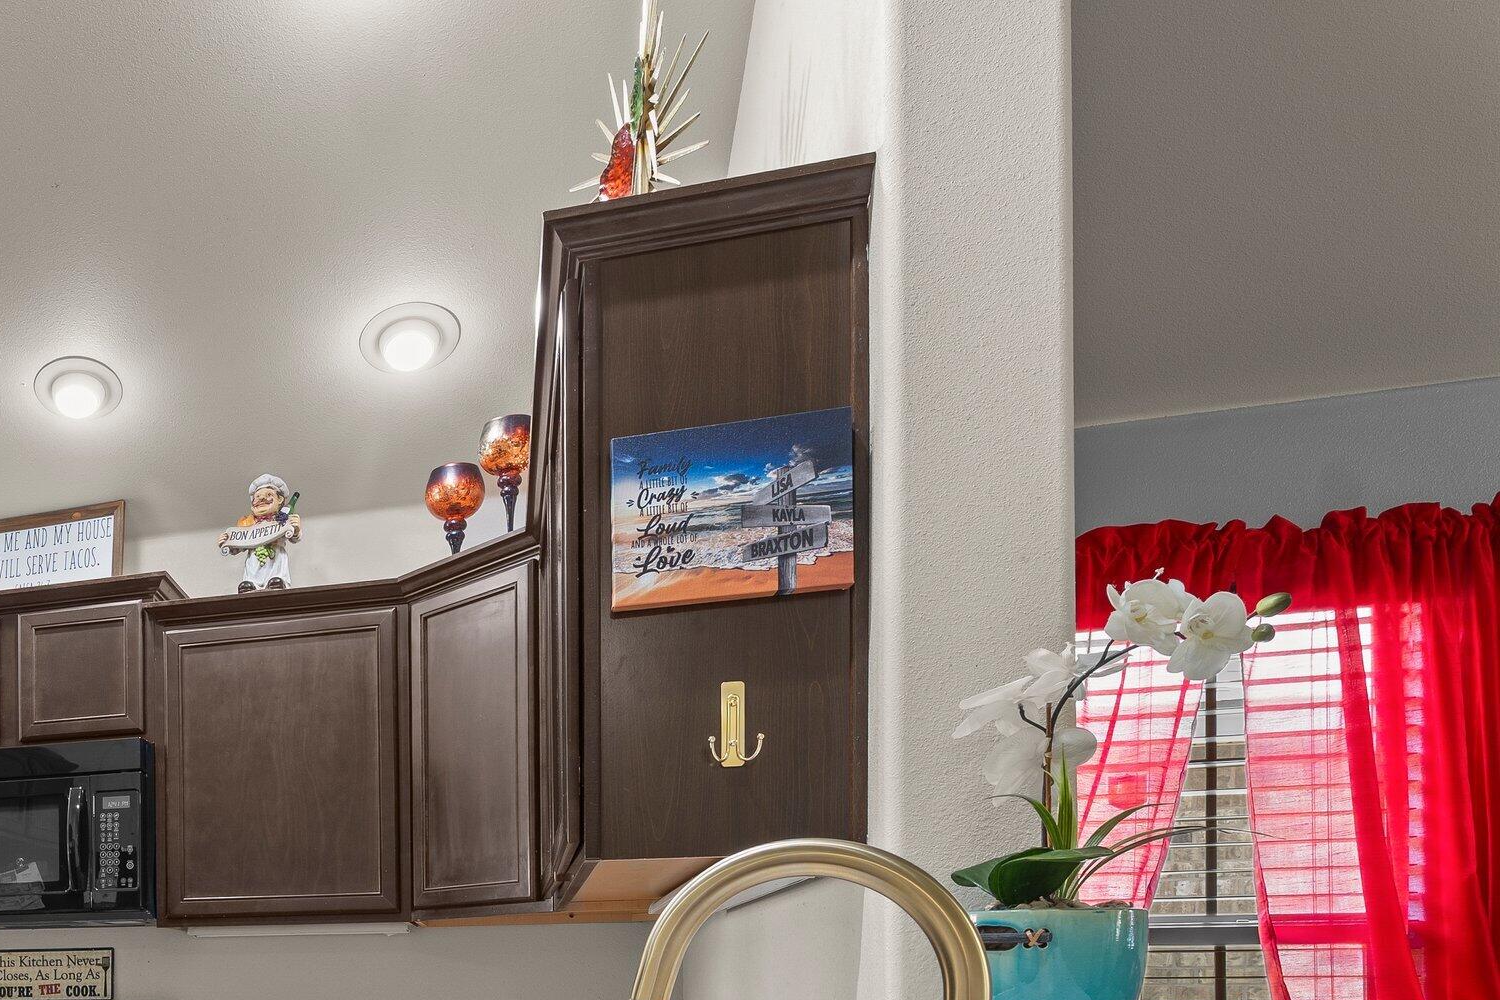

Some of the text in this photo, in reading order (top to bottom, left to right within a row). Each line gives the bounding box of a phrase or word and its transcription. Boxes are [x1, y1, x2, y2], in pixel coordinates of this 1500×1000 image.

[636, 457, 693, 479] Family
[646, 477, 665, 489] LITTLE
[668, 475, 678, 487] BIT
[771, 473, 794, 498] LISA
[636, 485, 688, 510] Crazy
[646, 504, 665, 517] LITTLE
[668, 503, 678, 514] BIT
[680, 501, 688, 513] OF
[772, 507, 806, 523] KAYLA
[4, 532, 20, 552] ME
[25, 528, 48, 550] AND
[53, 523, 72, 546] MY
[78, 517, 112, 542] HOUSE
[230, 530, 249, 541] BON
[636, 512, 695, 541] Loud
[631, 540, 646, 550] AND
[676, 533, 689, 545] LOT
[690, 532, 698, 543] OF
[750, 528, 814, 559] BRAXTON
[26, 552, 58, 576] SERVE
[64, 546, 100, 571] TACOS.
[633, 545, 696, 578] Love
[18, 955, 64, 968] Kitchen
[66, 954, 102, 967] Never
[34, 970, 50, 981] As
[53, 968, 83, 982] Long
[85, 968, 101, 980] As
[38, 983, 61, 996] THE
[65, 985, 101, 997] COOK.
